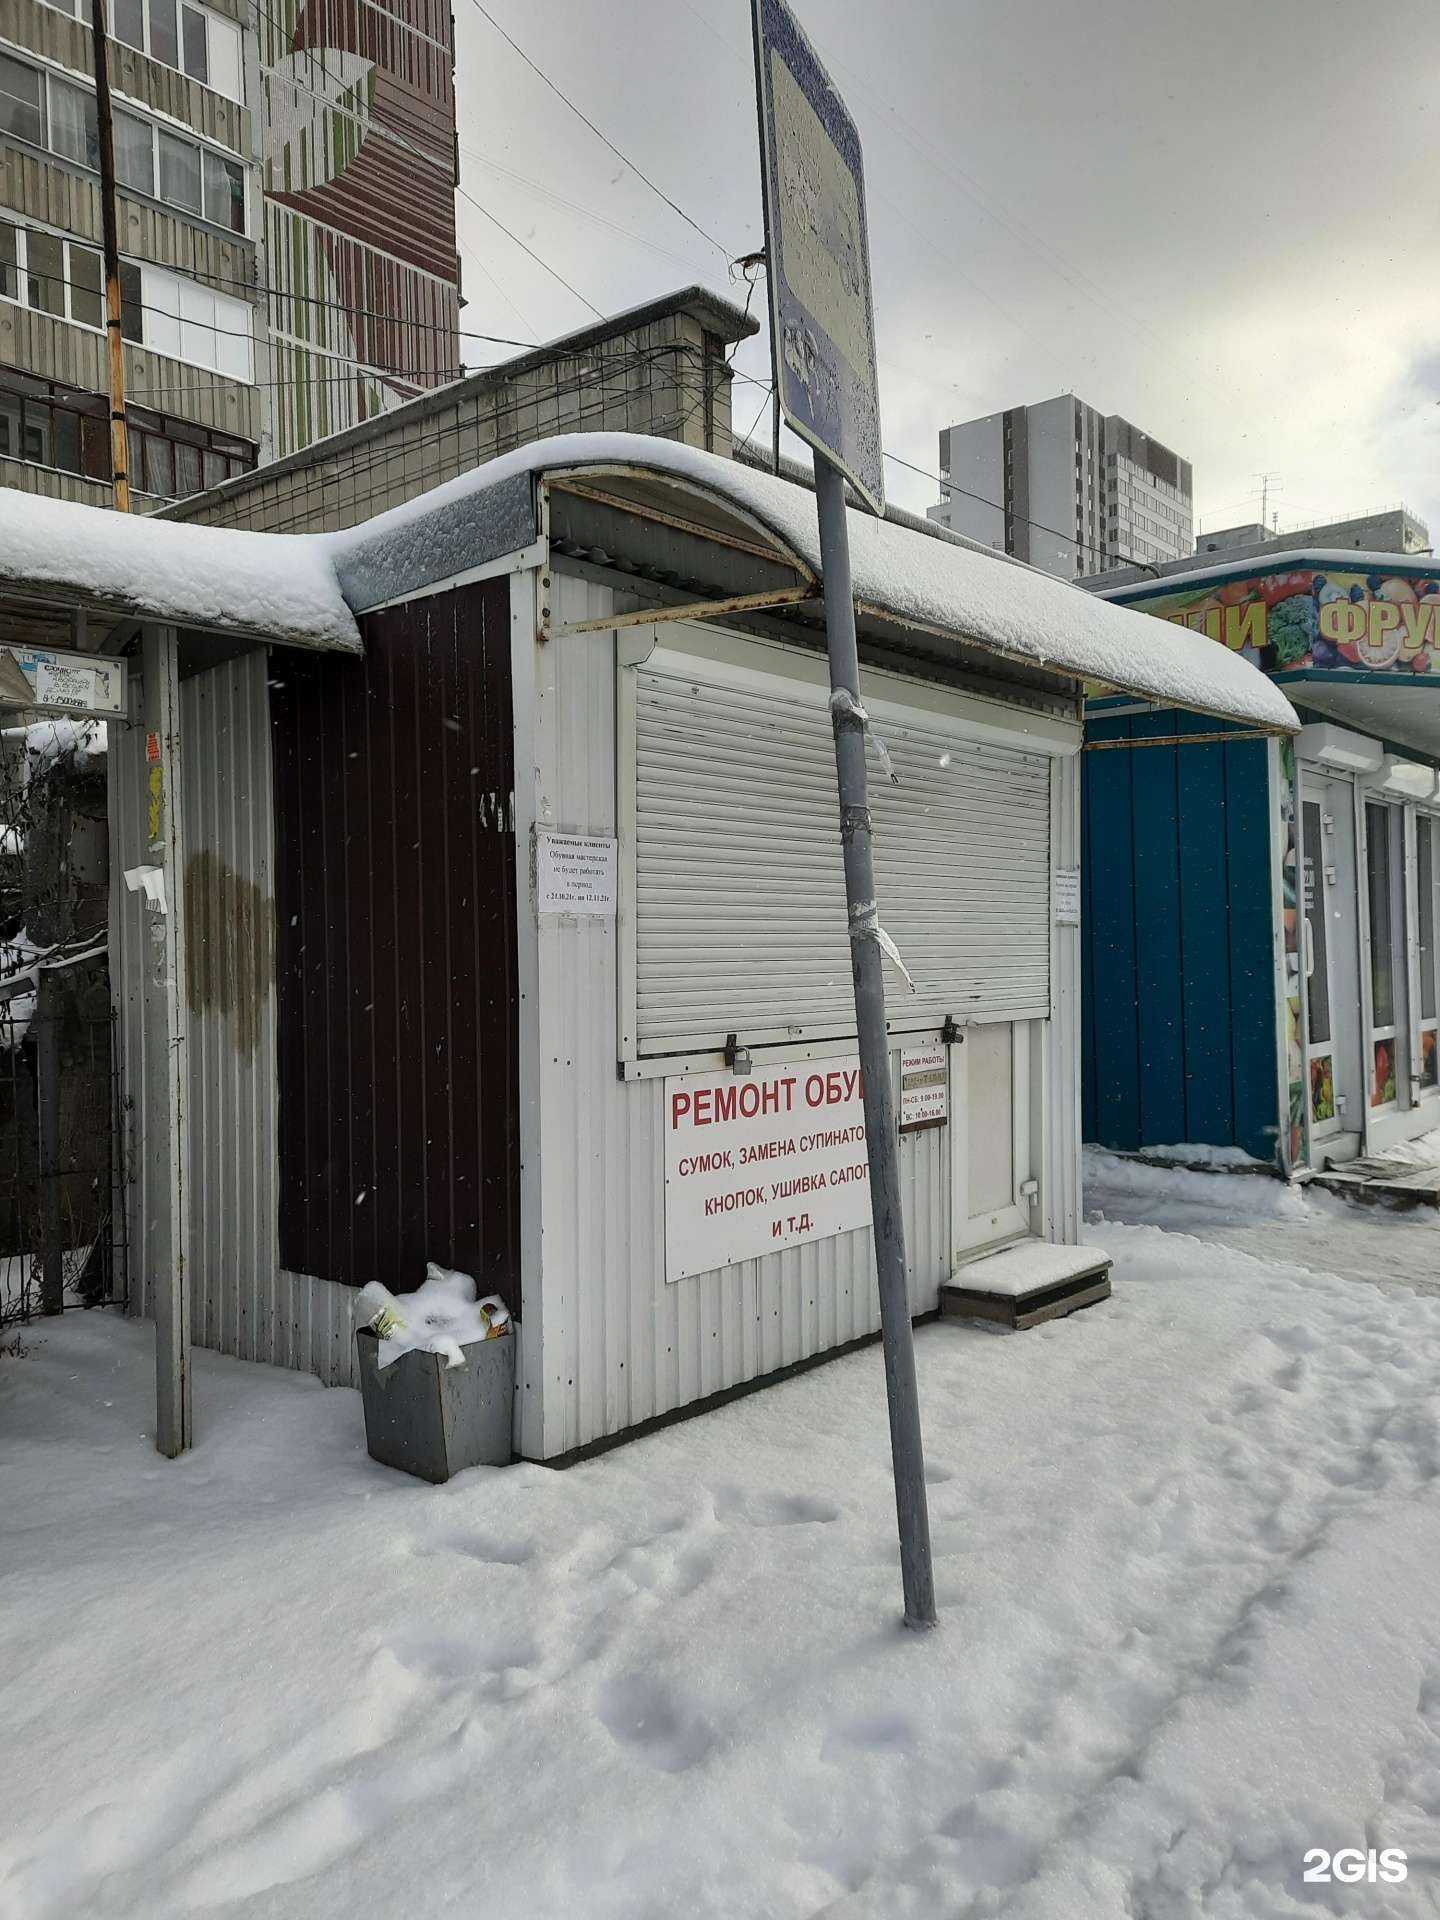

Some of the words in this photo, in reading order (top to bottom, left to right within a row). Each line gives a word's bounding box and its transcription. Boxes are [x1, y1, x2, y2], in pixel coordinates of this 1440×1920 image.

[1319, 597, 1440, 649] ФРУ
[549, 851, 575, 860] Обувная
[584, 841, 611, 849] клиенты
[561, 865, 578, 875] будет
[579, 867, 605, 876] работать
[903, 1059, 921, 1067] РЕЖИМ
[922, 1056, 944, 1064] РАБОТЫ
[671, 1077, 797, 1130] РЕМОНТ
[678, 1149, 735, 1177] СУМОК,
[738, 1137, 797, 1166] ЗАМЕНА
[799, 1125, 866, 1152] СУПИНАТО
[704, 1190, 768, 1217] КНОПОК,
[771, 1174, 827, 1202] УШИВКА
[772, 1220, 782, 1237] И
[786, 1213, 815, 1235] Т.Д.
